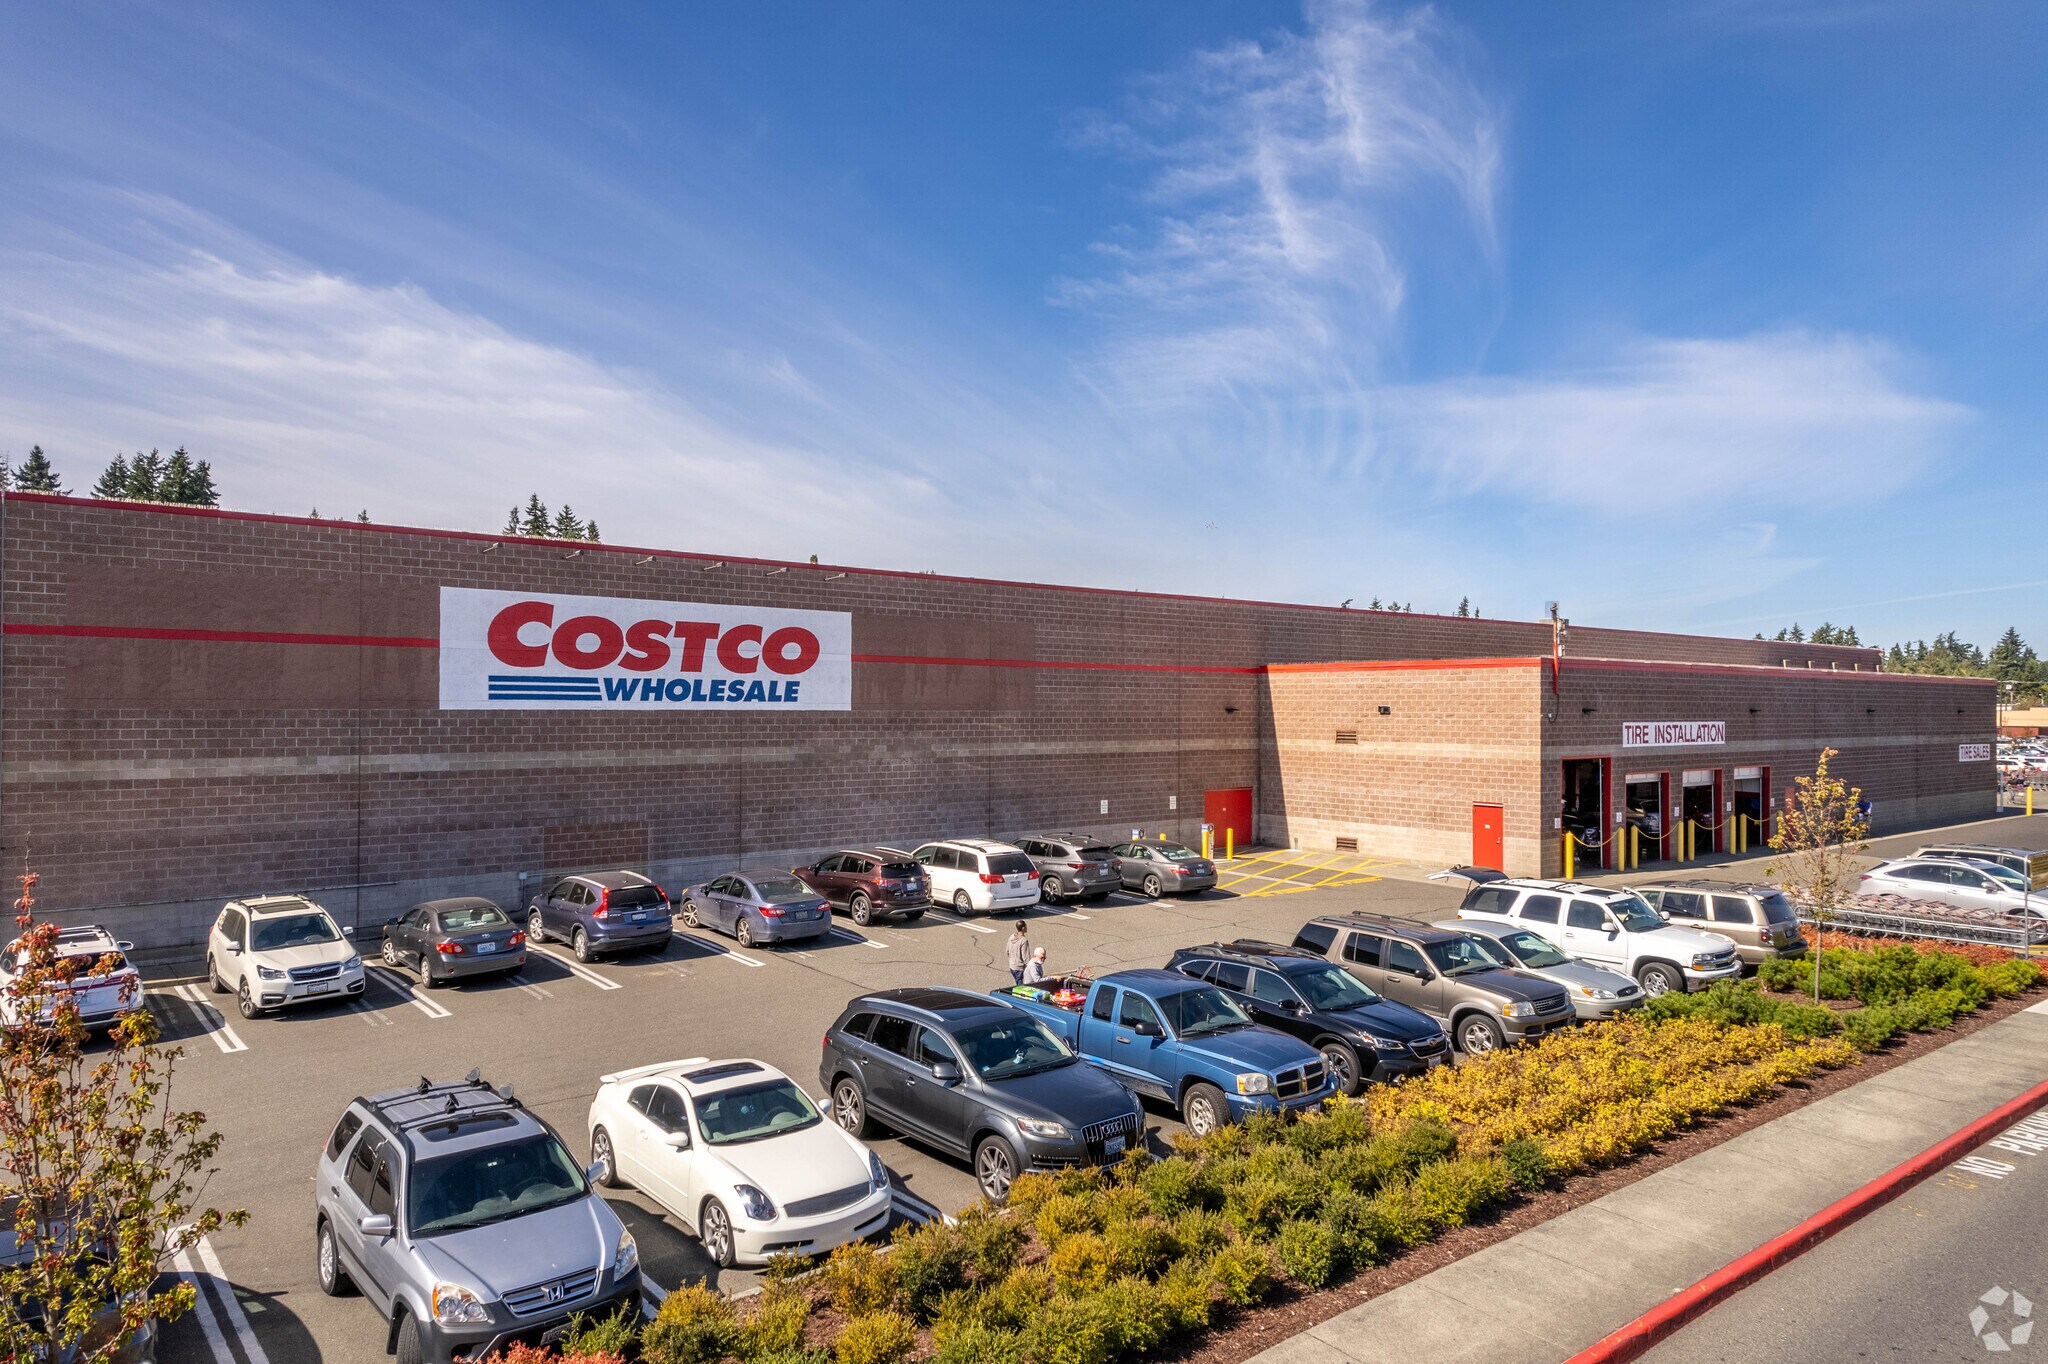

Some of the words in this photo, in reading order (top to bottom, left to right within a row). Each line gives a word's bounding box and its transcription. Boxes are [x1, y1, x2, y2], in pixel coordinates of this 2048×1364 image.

[487, 601, 820, 675] COSTCO
[603, 677, 801, 702] WHOLESALE
[1625, 725, 1649, 744] TIRE
[1654, 724, 1724, 743] INSTALLATION
[1960, 746, 1972, 759] TIRE
[1973, 745, 1989, 759] SALES
[1953, 1156, 2016, 1179] NO
[1988, 1112, 2048, 1156] PARKIN
